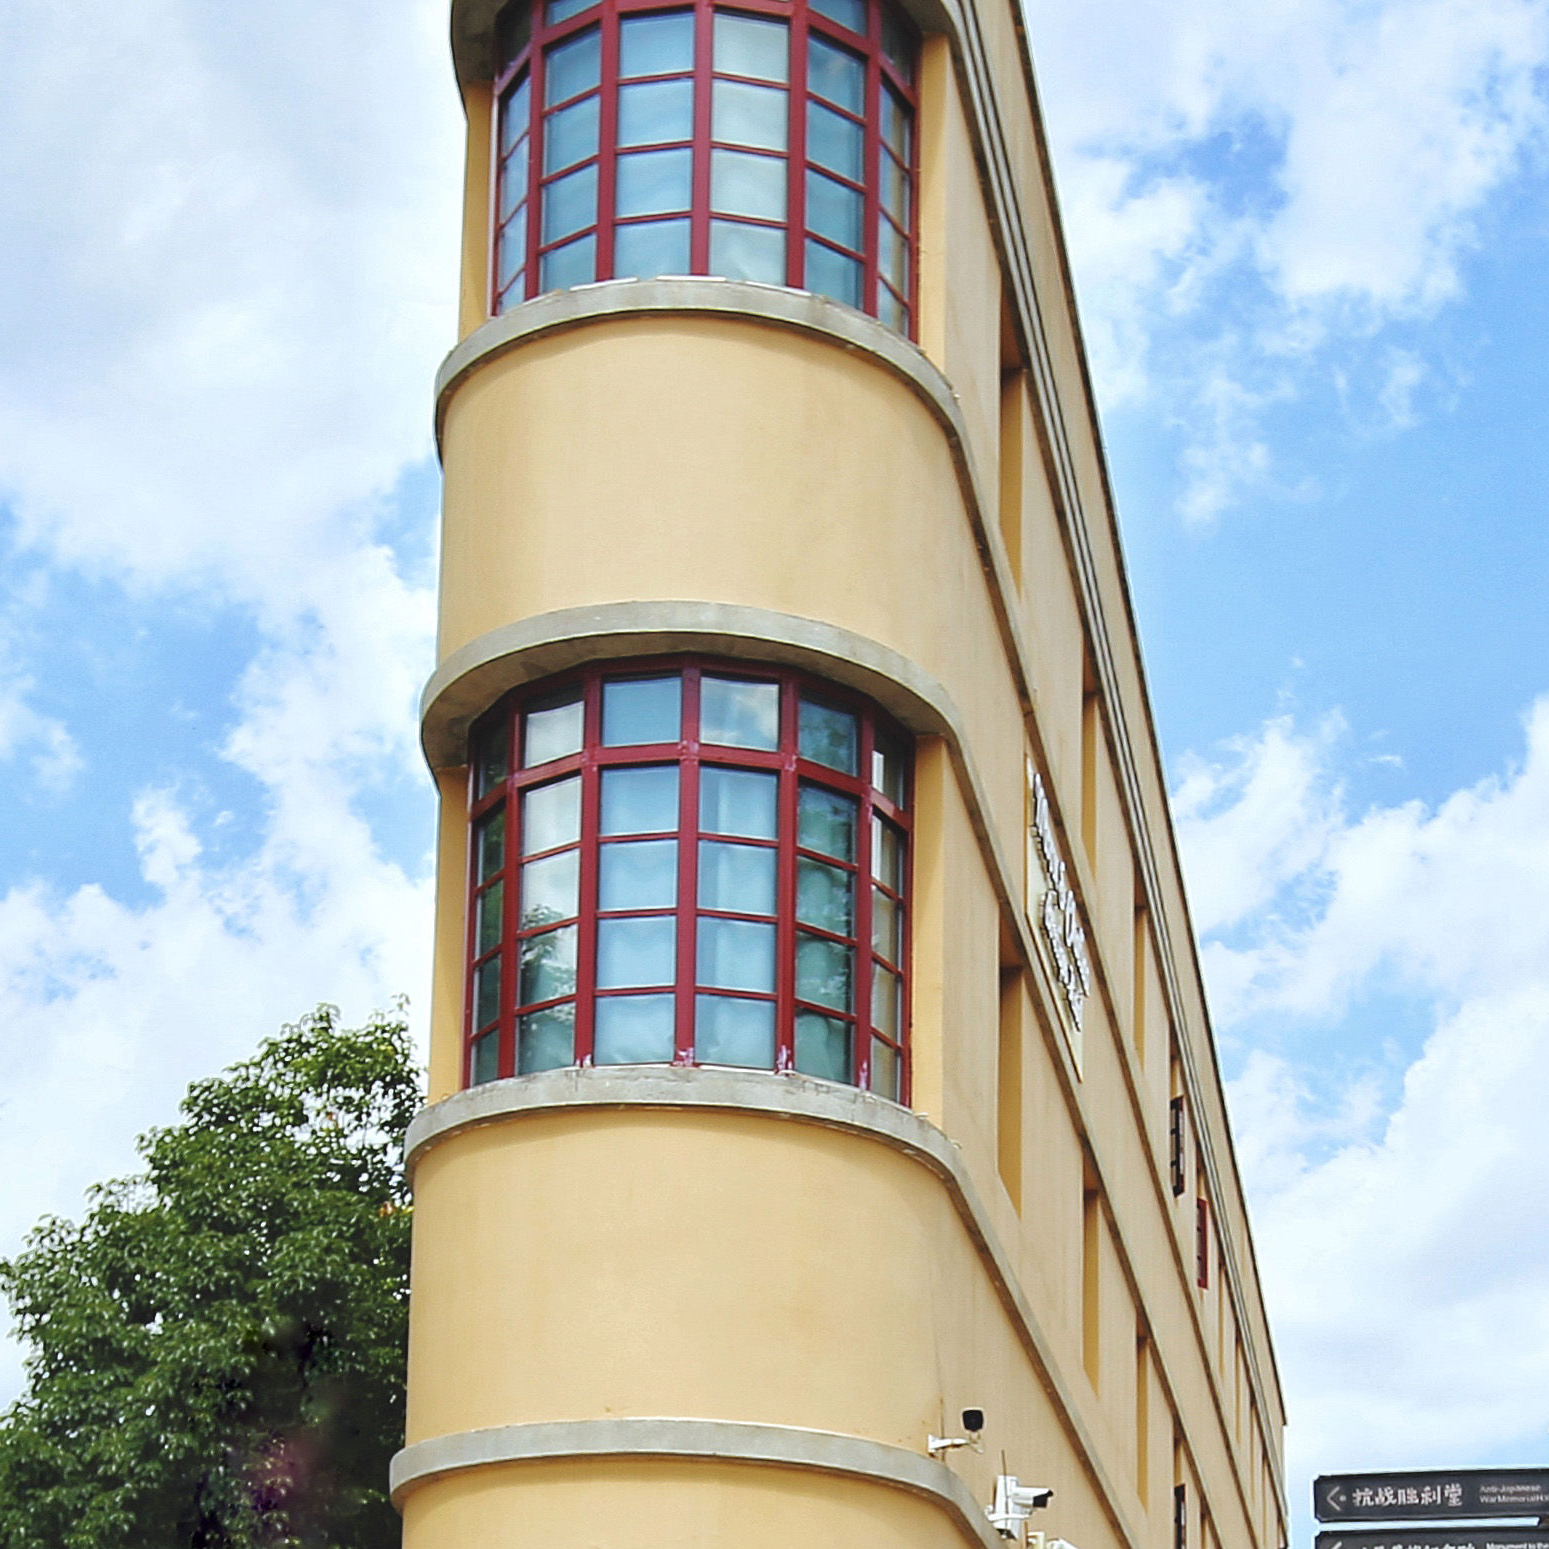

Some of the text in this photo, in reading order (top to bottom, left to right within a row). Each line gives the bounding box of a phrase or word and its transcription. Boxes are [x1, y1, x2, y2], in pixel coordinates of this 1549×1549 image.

[1480, 1483, 1542, 1494] Anti-Japanese
[1352, 1483, 1463, 1507] 抗战胜利堂
[1479, 1494, 1496, 1503] War
[1498, 1494, 1537, 1503] Memorial
[1528, 1542, 1537, 1549] to
[1537, 1541, 1549, 1549] the
